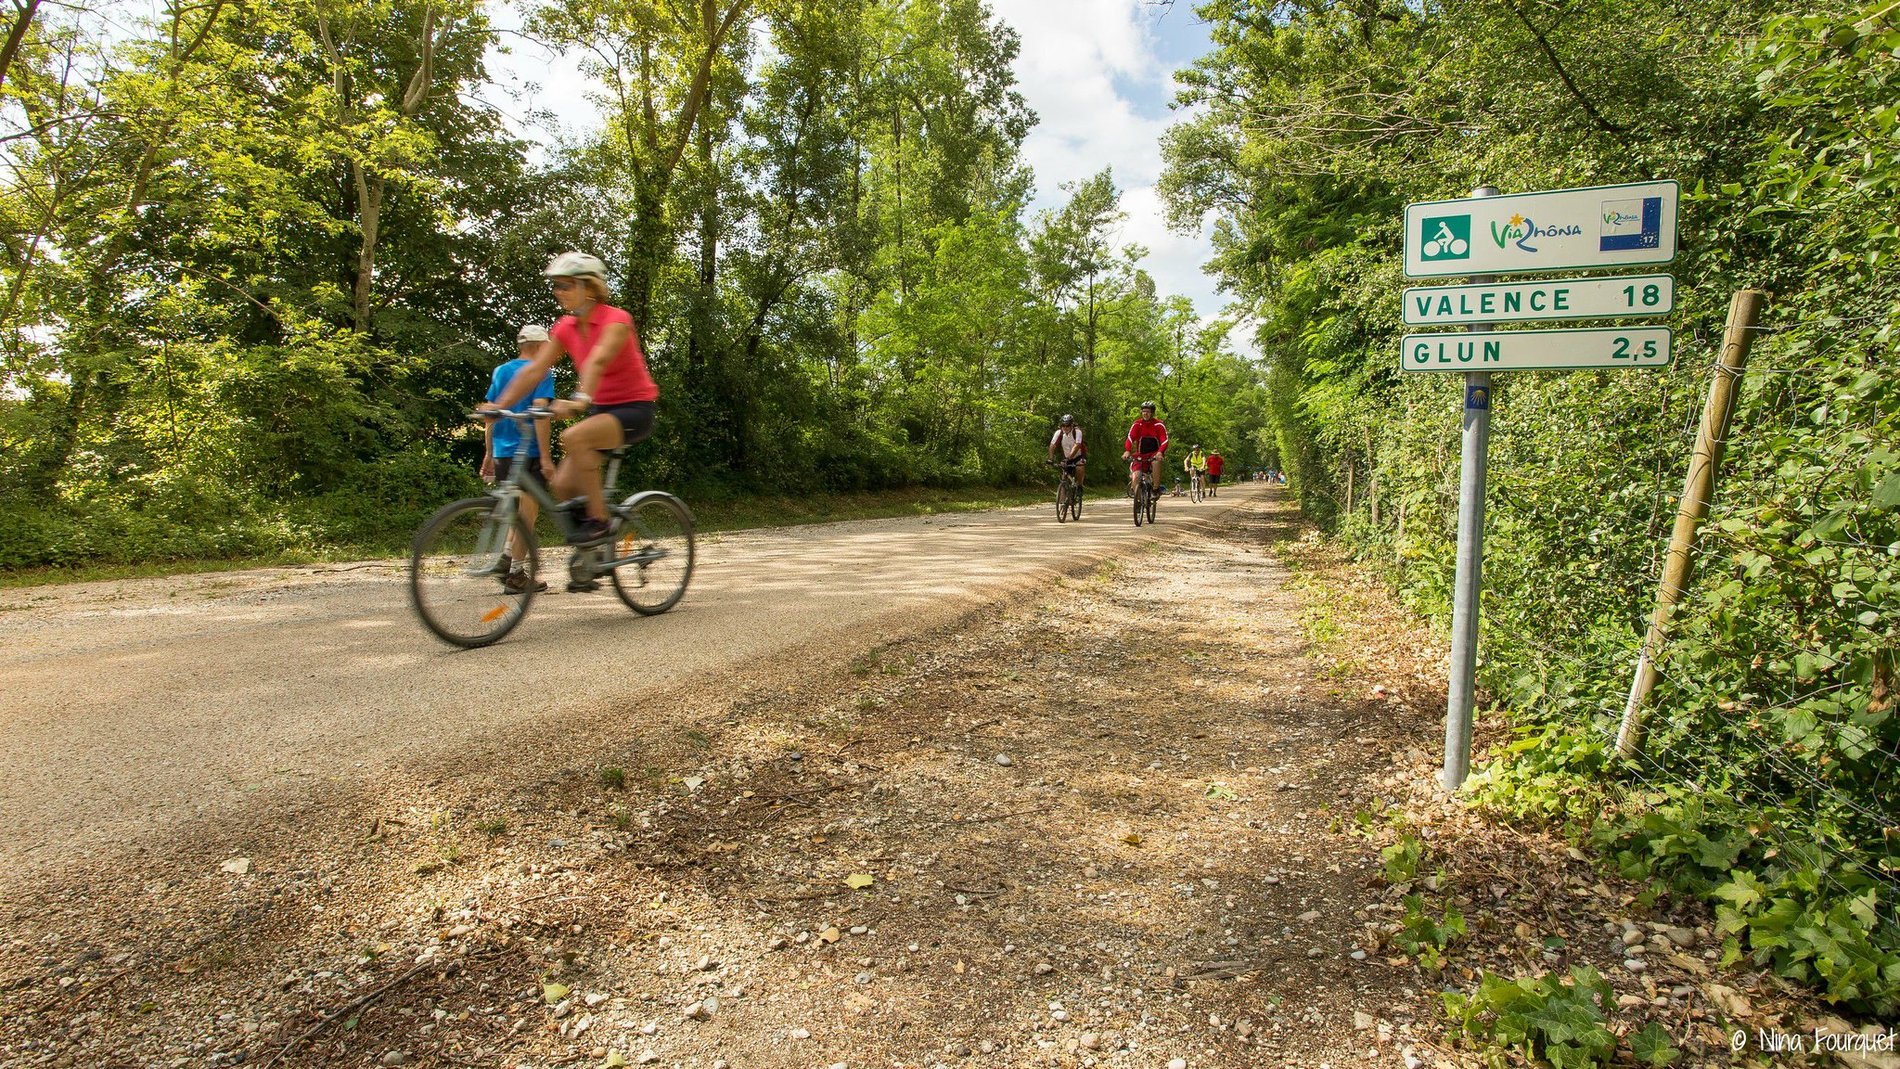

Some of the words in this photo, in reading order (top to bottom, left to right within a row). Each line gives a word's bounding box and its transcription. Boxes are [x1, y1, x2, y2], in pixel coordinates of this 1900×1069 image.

[1643, 235, 1655, 244] 17
[1416, 289, 1570, 317] VALENCE
[1623, 284, 1660, 307] 18
[1413, 341, 1501, 364] GLUN
[1612, 337, 1658, 362] 2,5
